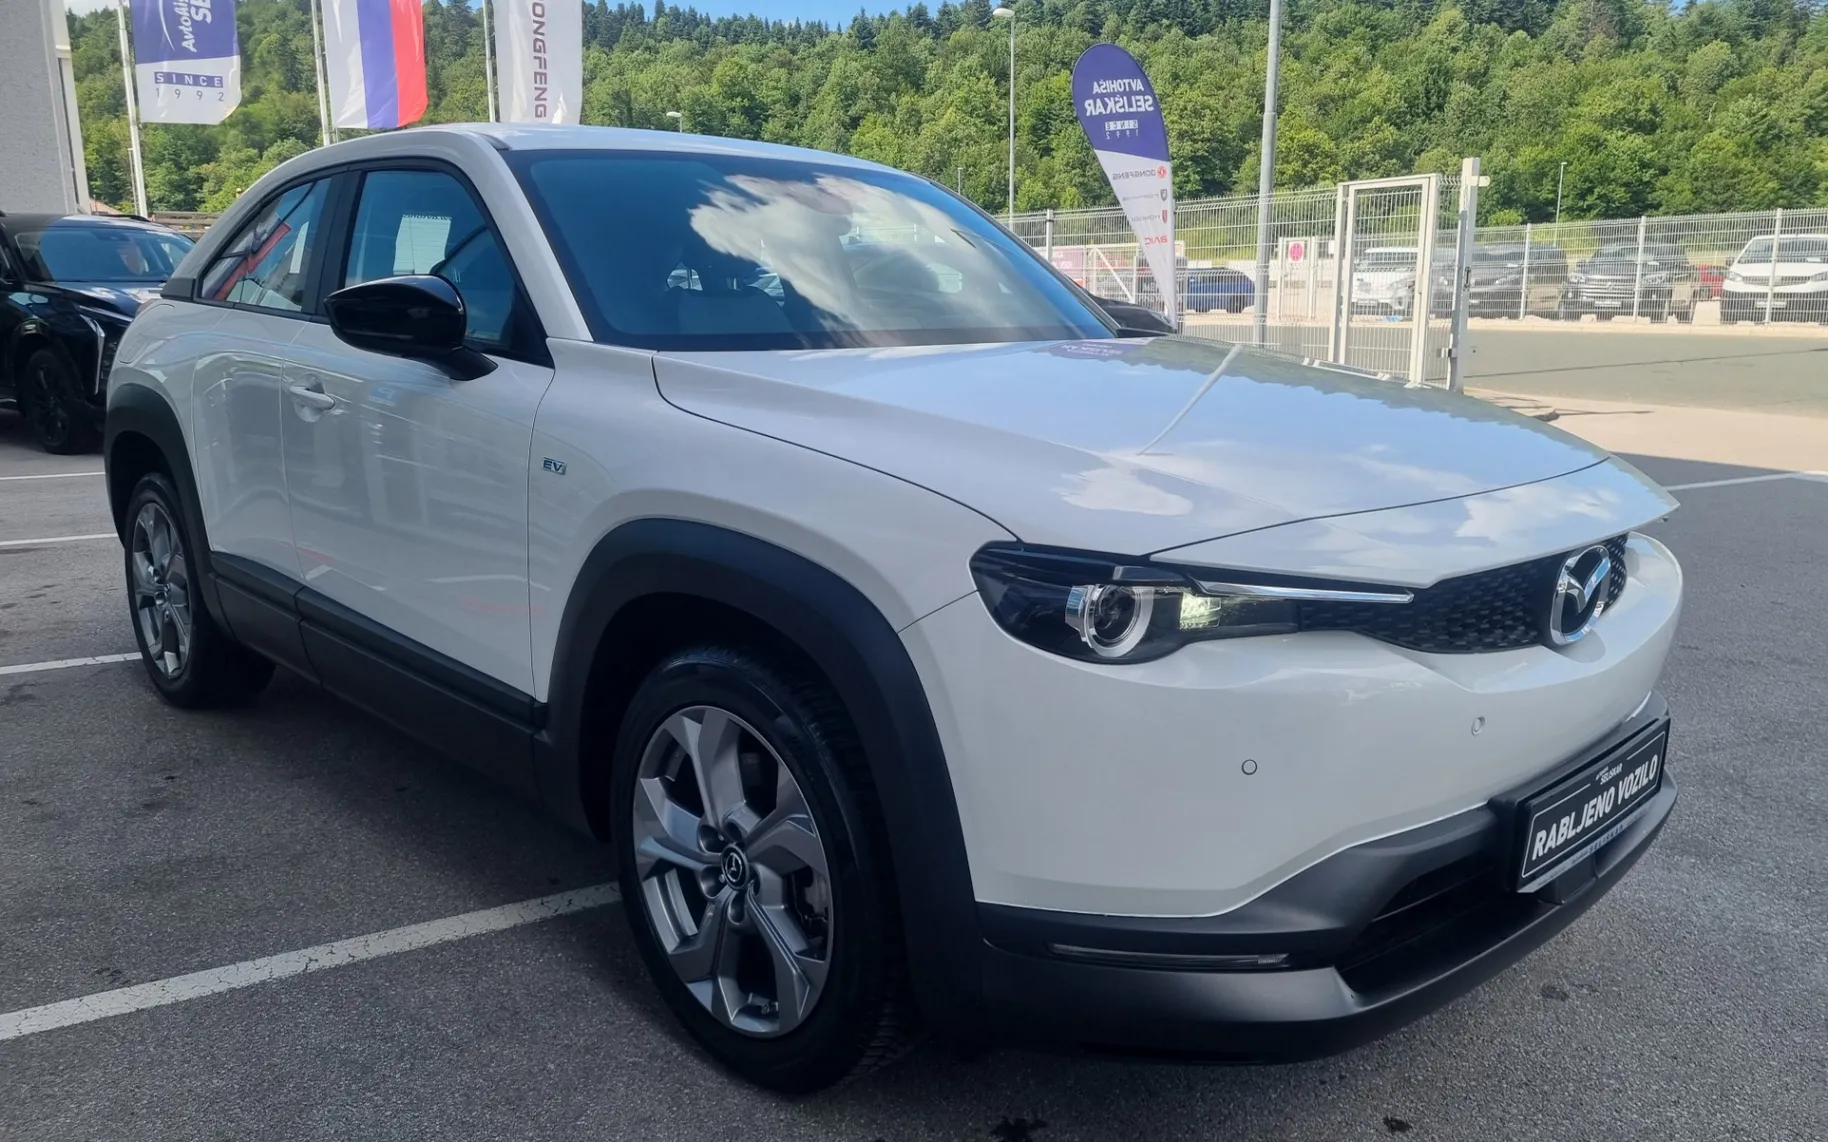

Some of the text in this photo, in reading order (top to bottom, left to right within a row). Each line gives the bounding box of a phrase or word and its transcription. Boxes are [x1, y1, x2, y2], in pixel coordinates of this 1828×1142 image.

[156, 73, 222, 87] SINCE
[156, 88, 224, 101] 1992
[543, 460, 563, 471] EV
[1532, 754, 1658, 860] RABLJENO VOZILO
